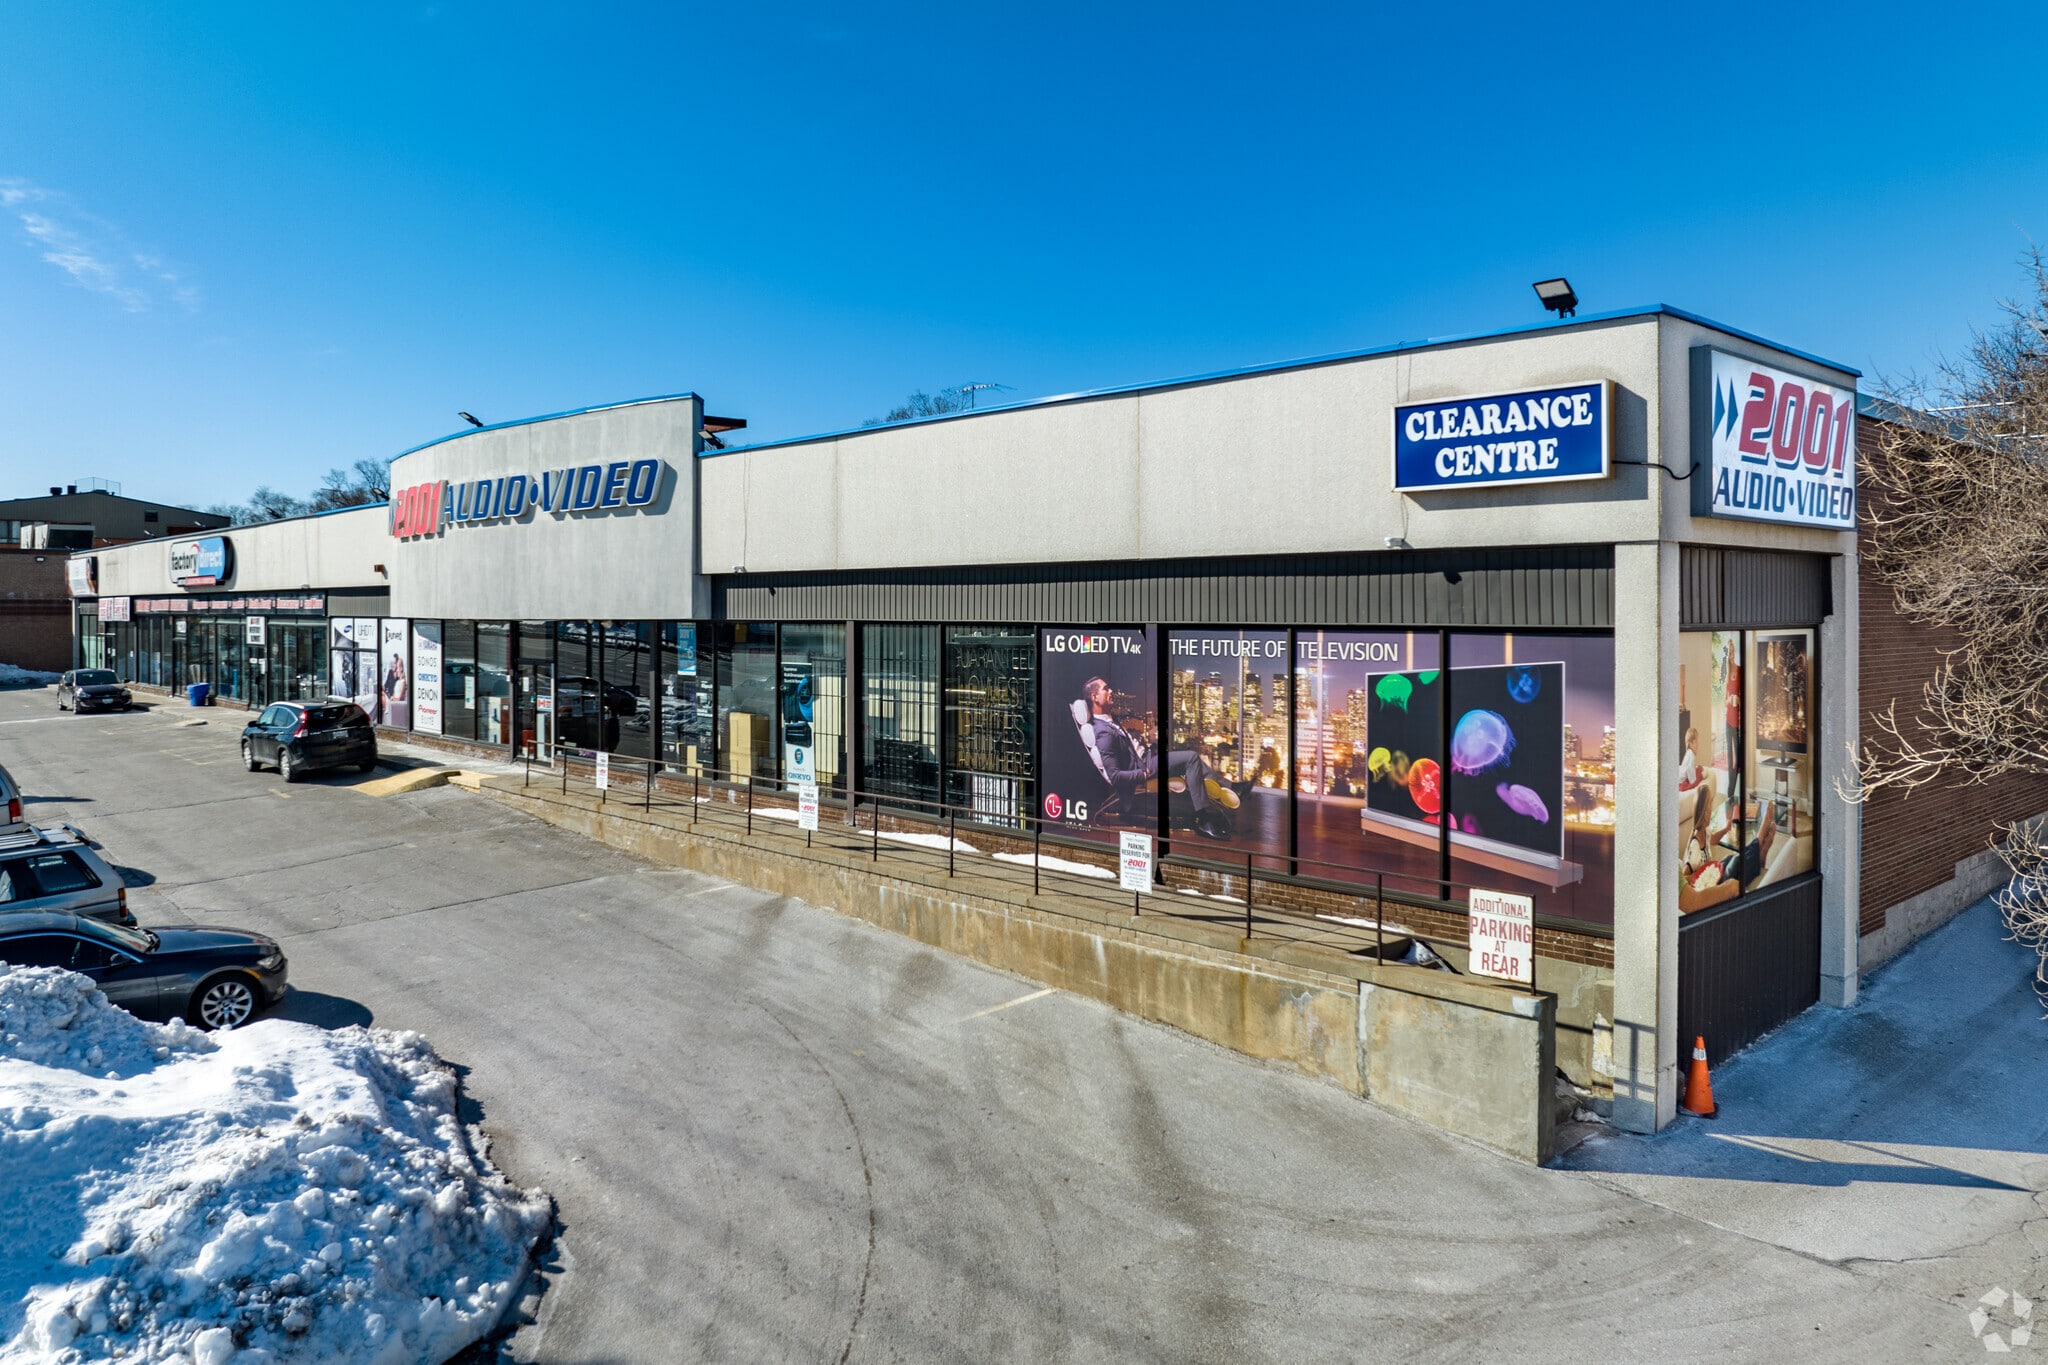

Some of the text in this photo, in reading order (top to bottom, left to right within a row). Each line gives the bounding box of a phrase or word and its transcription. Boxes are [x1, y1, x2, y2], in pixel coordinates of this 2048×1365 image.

[1405, 392, 1593, 442] CLEARANCE
[1739, 371, 1852, 477] 2001
[1435, 437, 1559, 478] CENTRE
[393, 479, 442, 538] 2001
[171, 545, 222, 574] factory direct
[1046, 635, 1065, 652] LG
[1068, 635, 1109, 654] OLED
[1169, 638, 1398, 662] THE FUTURE OF TELEVISION
[417, 688, 438, 700] DENON
[788, 771, 811, 781] ONKYO
[1066, 798, 1087, 820] LG
[1122, 849, 1141, 858] RESERVED
[1127, 842, 1145, 851] PARKING
[1127, 858, 1146, 868] 2001
[1473, 897, 1529, 919] ADDITIONAL
[1469, 915, 1532, 944] PARKING
[1494, 939, 1507, 953] AT
[1481, 951, 1519, 976] REAR
